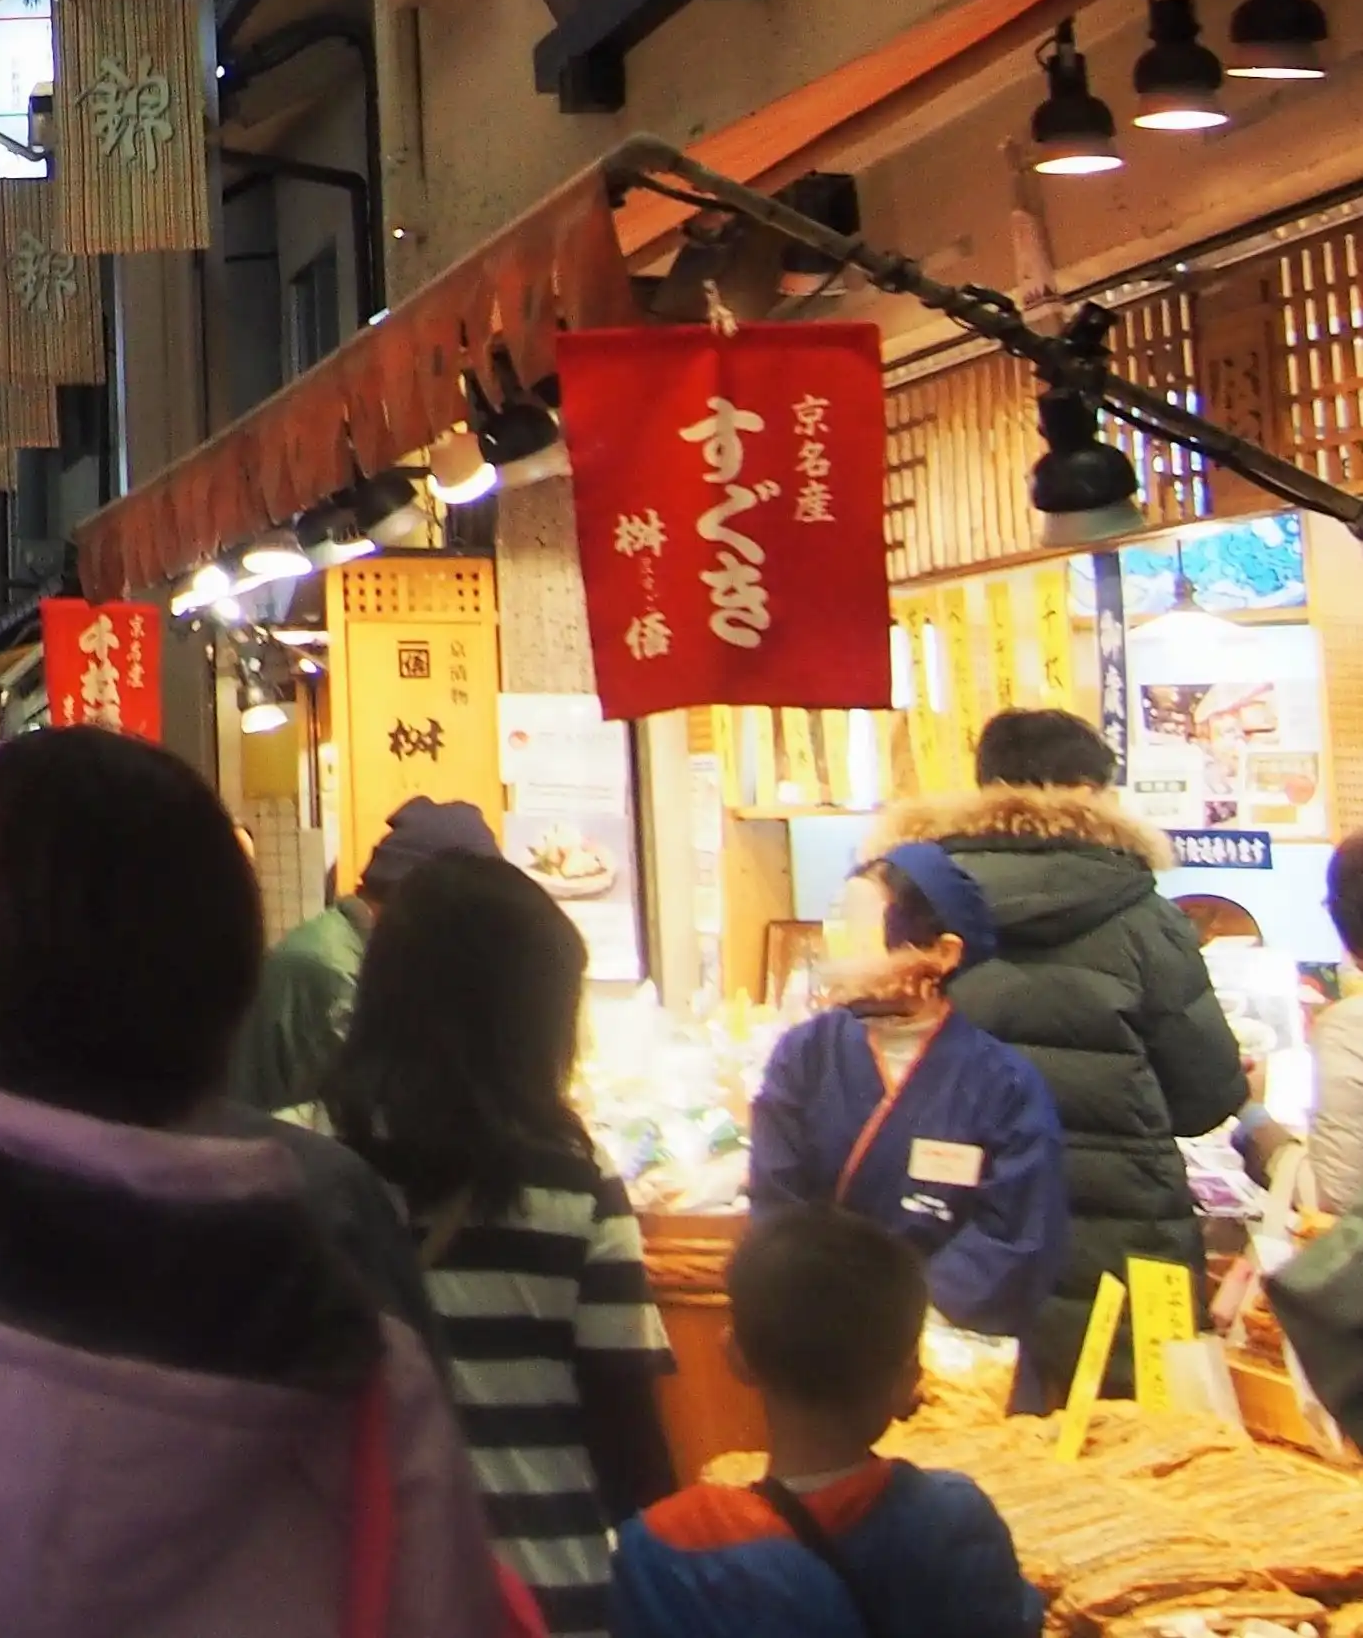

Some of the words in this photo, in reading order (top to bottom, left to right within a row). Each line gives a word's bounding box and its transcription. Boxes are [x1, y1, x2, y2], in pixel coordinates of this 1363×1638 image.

[75, 54, 176, 175] 錦
[678, 396, 782, 649] すぐき
[791, 392, 836, 524] 京名産
